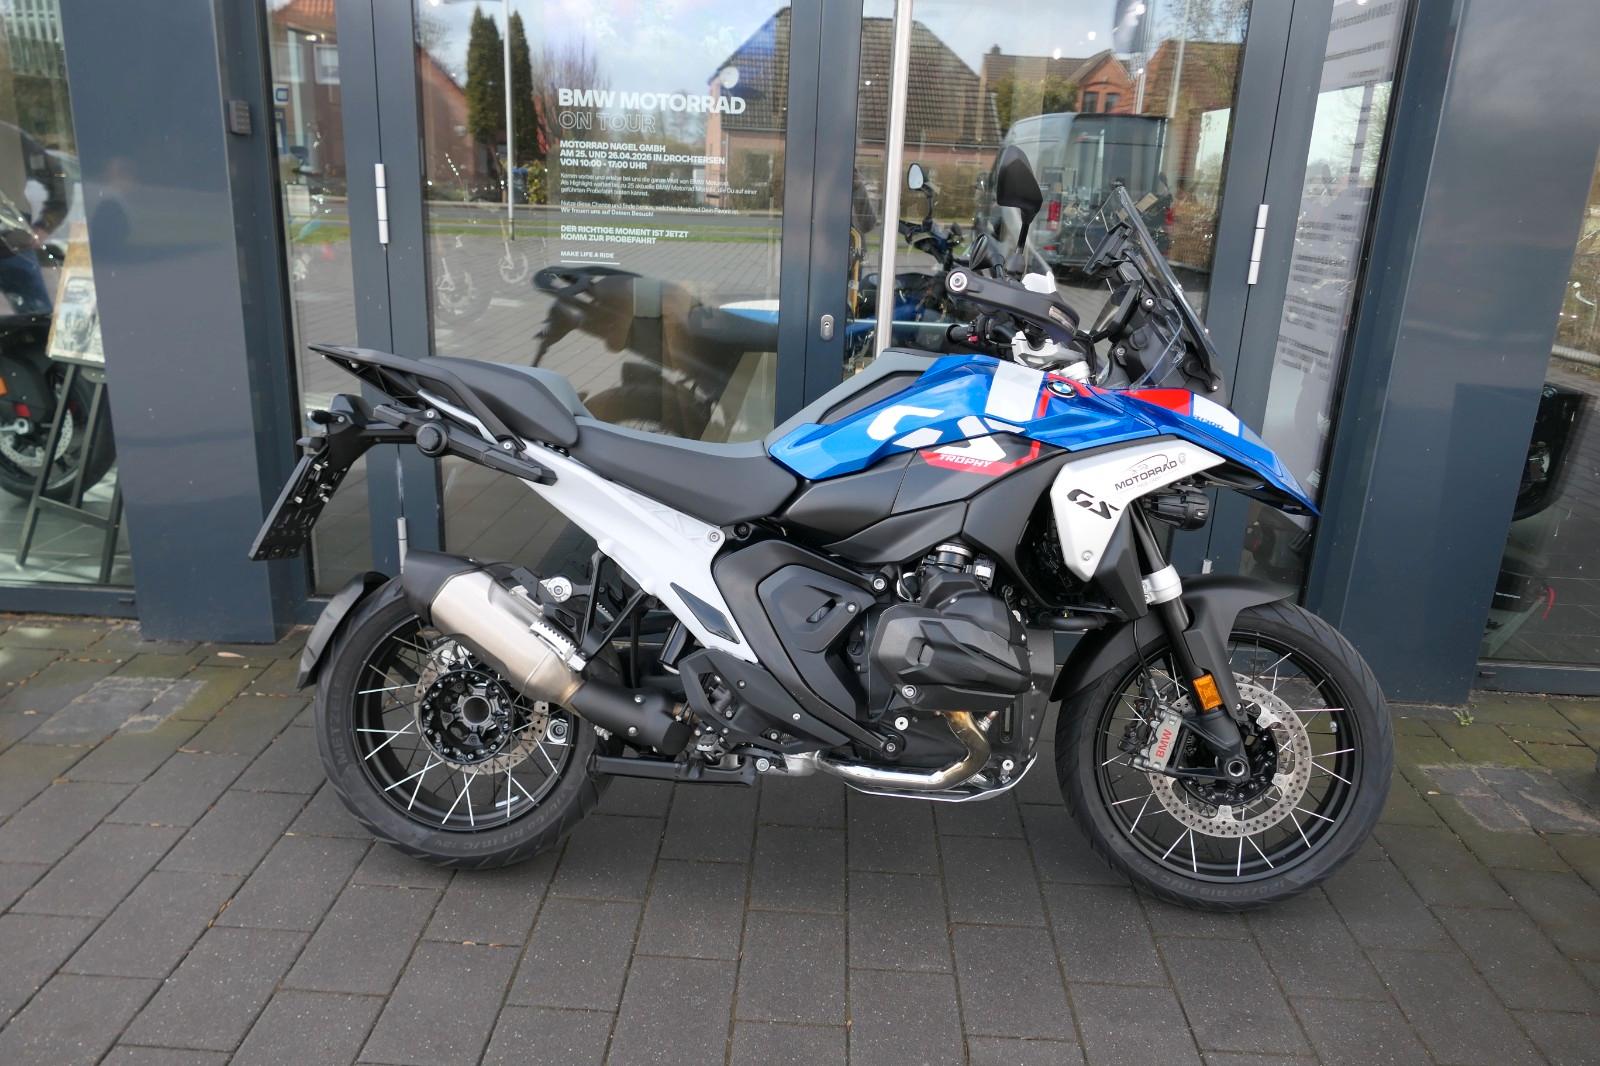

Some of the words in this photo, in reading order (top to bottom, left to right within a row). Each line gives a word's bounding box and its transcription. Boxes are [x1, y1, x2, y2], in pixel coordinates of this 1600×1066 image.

[558, 88, 616, 108] BMW
[620, 91, 746, 114] MOTORRAD
[558, 111, 592, 130] ON
[597, 112, 656, 133] TOUR
[560, 140, 609, 150] MOTORRAD
[610, 142, 638, 152] NAGEL
[638, 143, 666, 153] GMBH
[560, 149, 575, 158] AM
[575, 150, 588, 158] 25.
[588, 150, 608, 160] UND
[608, 152, 652, 161] 26.04.2026
[653, 153, 662, 162] IN
[663, 154, 726, 165] DROCHTERSEN
[560, 158, 580, 166] VON
[580, 158, 602, 168] 10:00
[608, 160, 628, 169] 17:00
[629, 160, 648, 170] UHR
[560, 225, 577, 233] DER
[578, 226, 614, 234] RICHTIGE
[614, 227, 652, 236] MOMENT
[652, 229, 664, 237] IST
[665, 230, 688, 238] JETZT
[560, 233, 587, 241] KOMM
[588, 234, 605, 242] ZUR
[606, 234, 656, 244] PROBEFAHRT
[560, 250, 580, 258] MAKE
[938, 453, 993, 468] TROPHY
[1114, 460, 1178, 491] MOTORRAD
[1155, 728, 1172, 758] BMW
